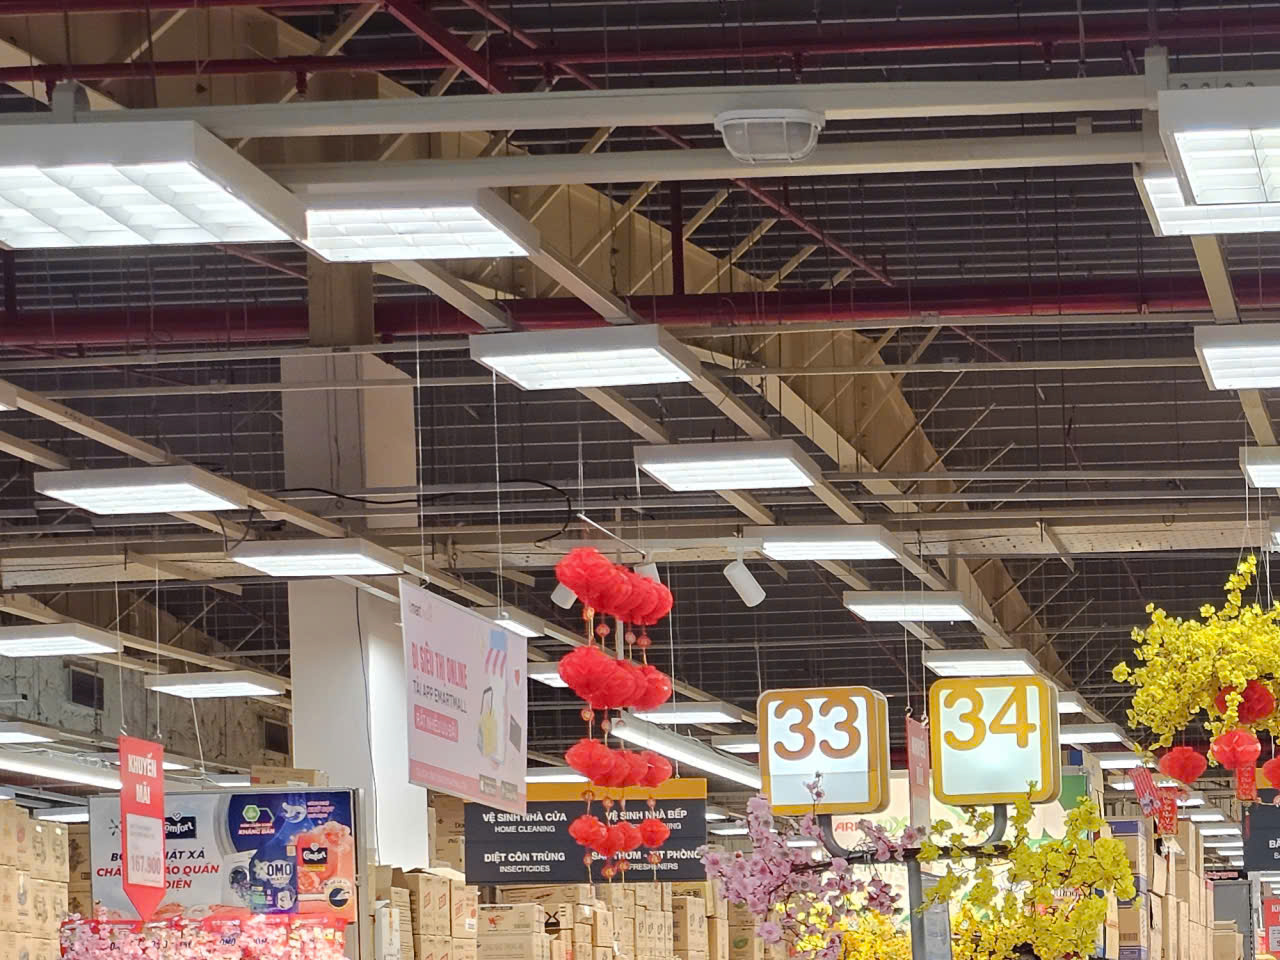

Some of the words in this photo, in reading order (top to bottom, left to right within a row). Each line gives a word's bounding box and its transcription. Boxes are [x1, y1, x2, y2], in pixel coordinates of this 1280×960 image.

[942, 685, 1036, 752] 34
[772, 693, 862, 760] 33
[128, 753, 157, 778] KHUYẾN
[135, 781, 151, 805] MÃI
[483, 813, 497, 824] VỆ
[499, 813, 521, 822] SINH
[545, 811, 567, 822] CỬA
[620, 811, 643, 821] SINH
[667, 808, 687, 820] BẾP
[165, 818, 194, 834] omfort
[518, 825, 556, 833] CLEANING
[187, 847, 205, 859] XẢ
[484, 852, 506, 865] DIỆT
[507, 850, 529, 862] CÔN
[531, 849, 565, 862] TRÙNG
[266, 863, 292, 876] OMO
[499, 865, 550, 873] INSECTICIDES
